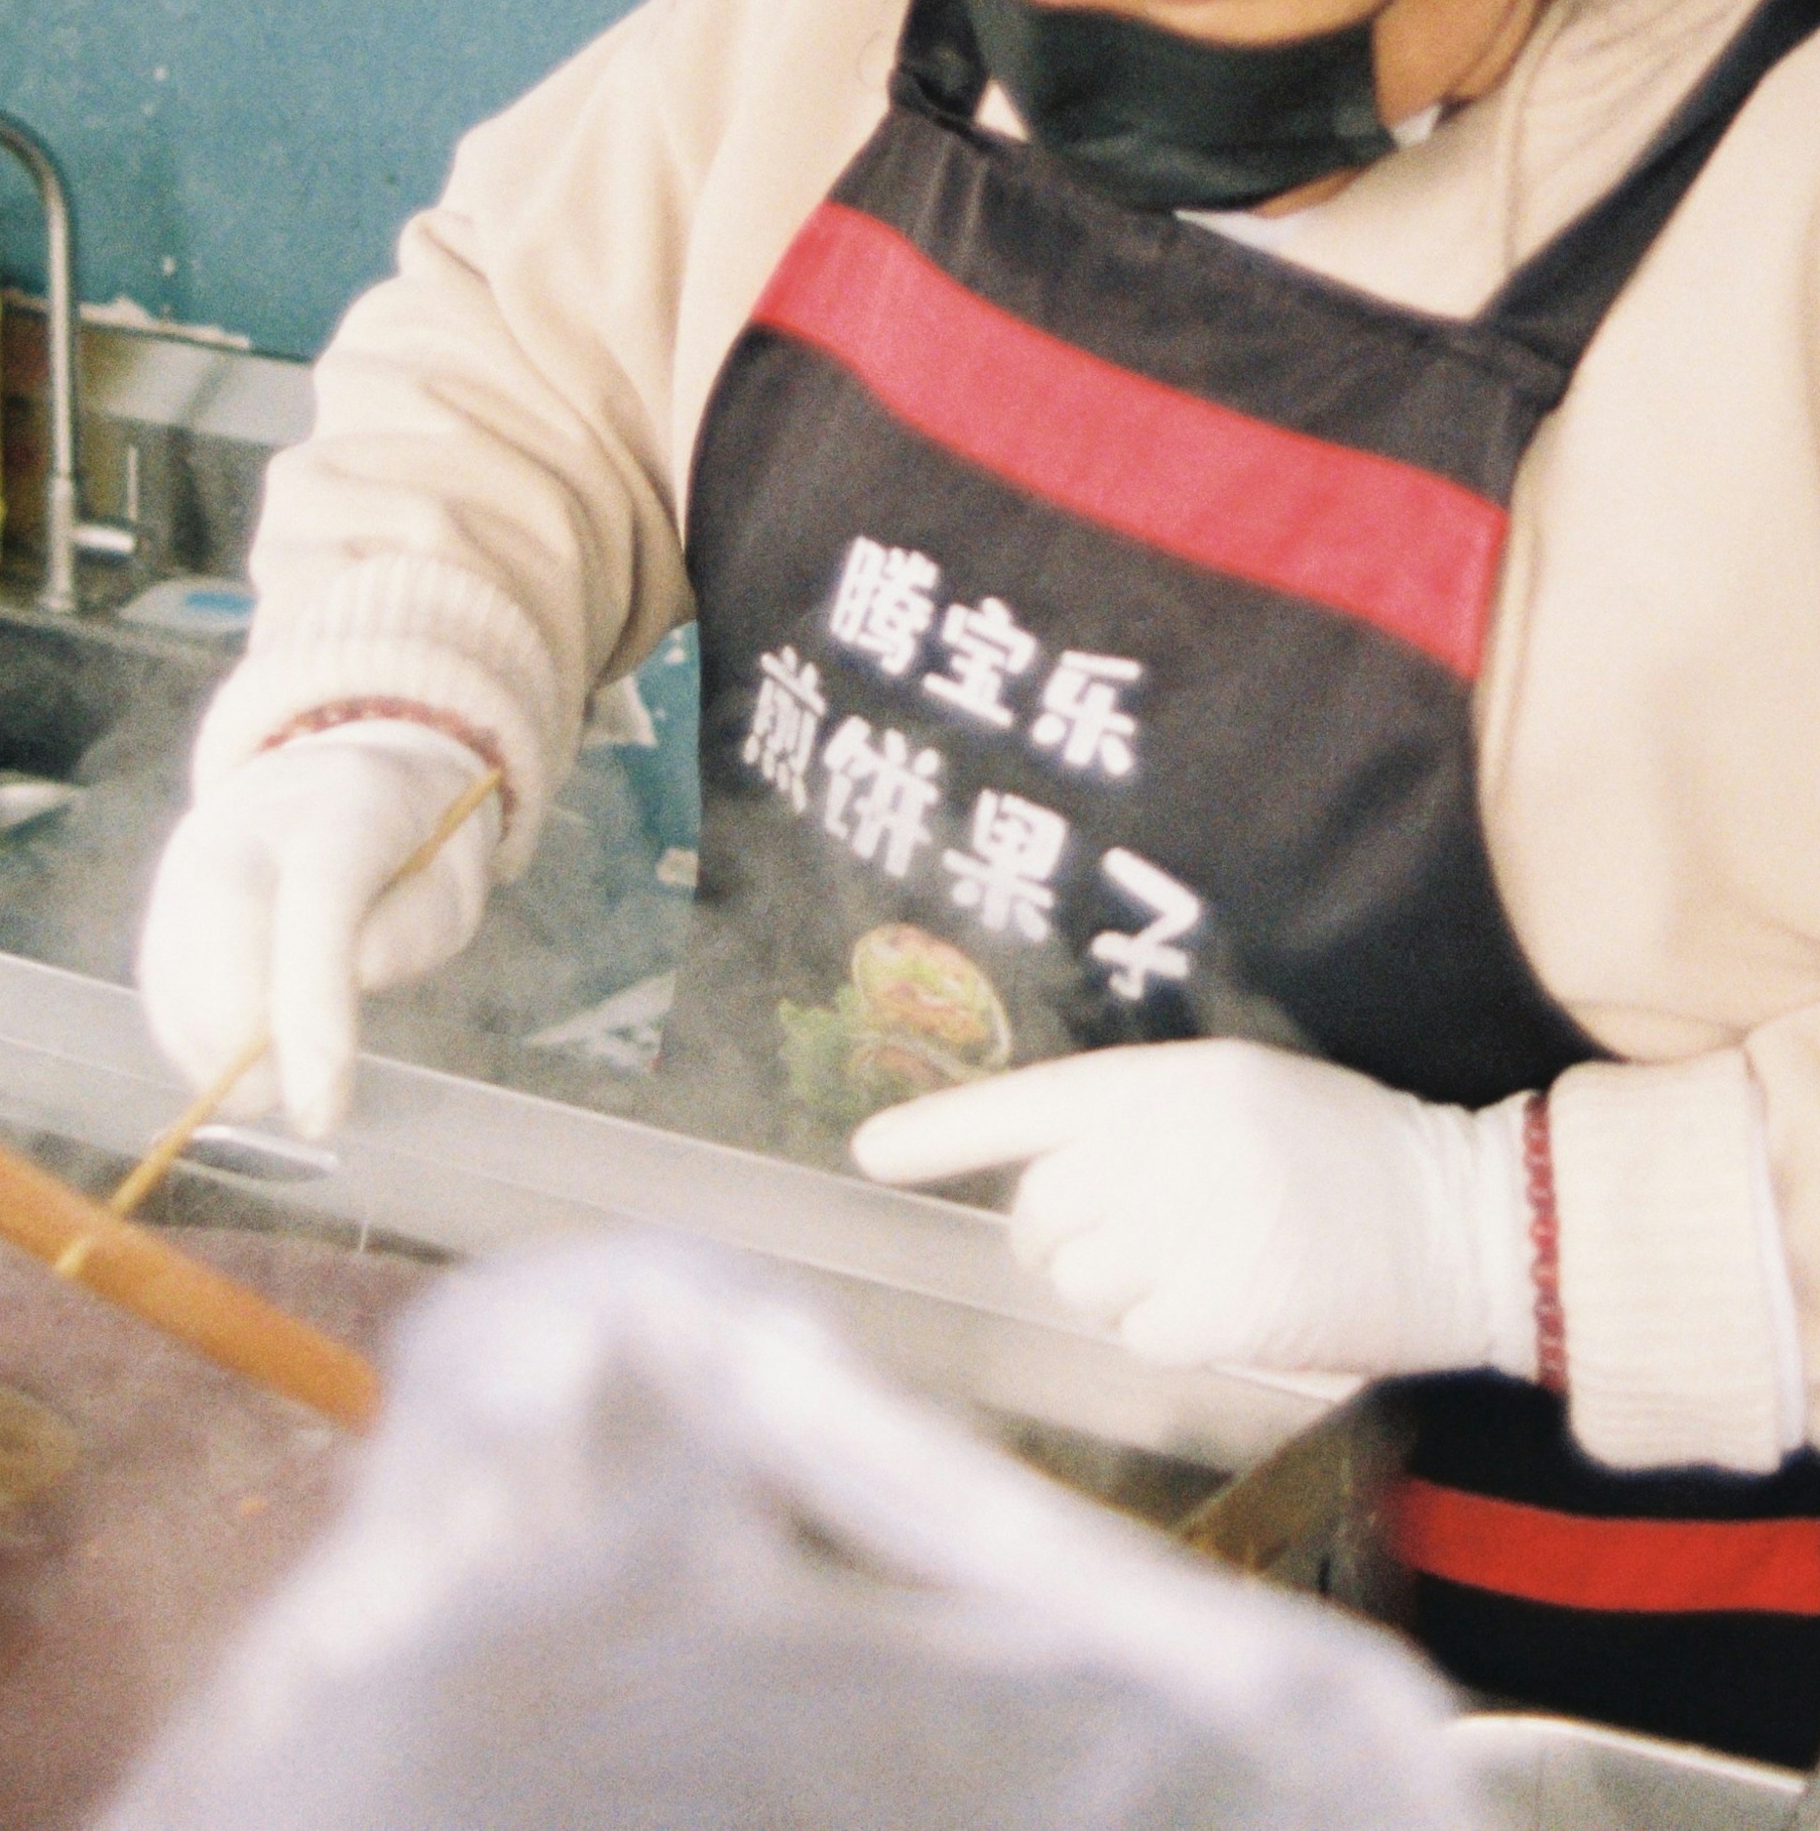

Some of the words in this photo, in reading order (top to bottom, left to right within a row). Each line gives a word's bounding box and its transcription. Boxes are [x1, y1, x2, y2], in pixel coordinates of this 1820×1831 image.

[829, 535, 1144, 778] 腾宝乐
[743, 644, 1203, 1002] 煎饼果子
